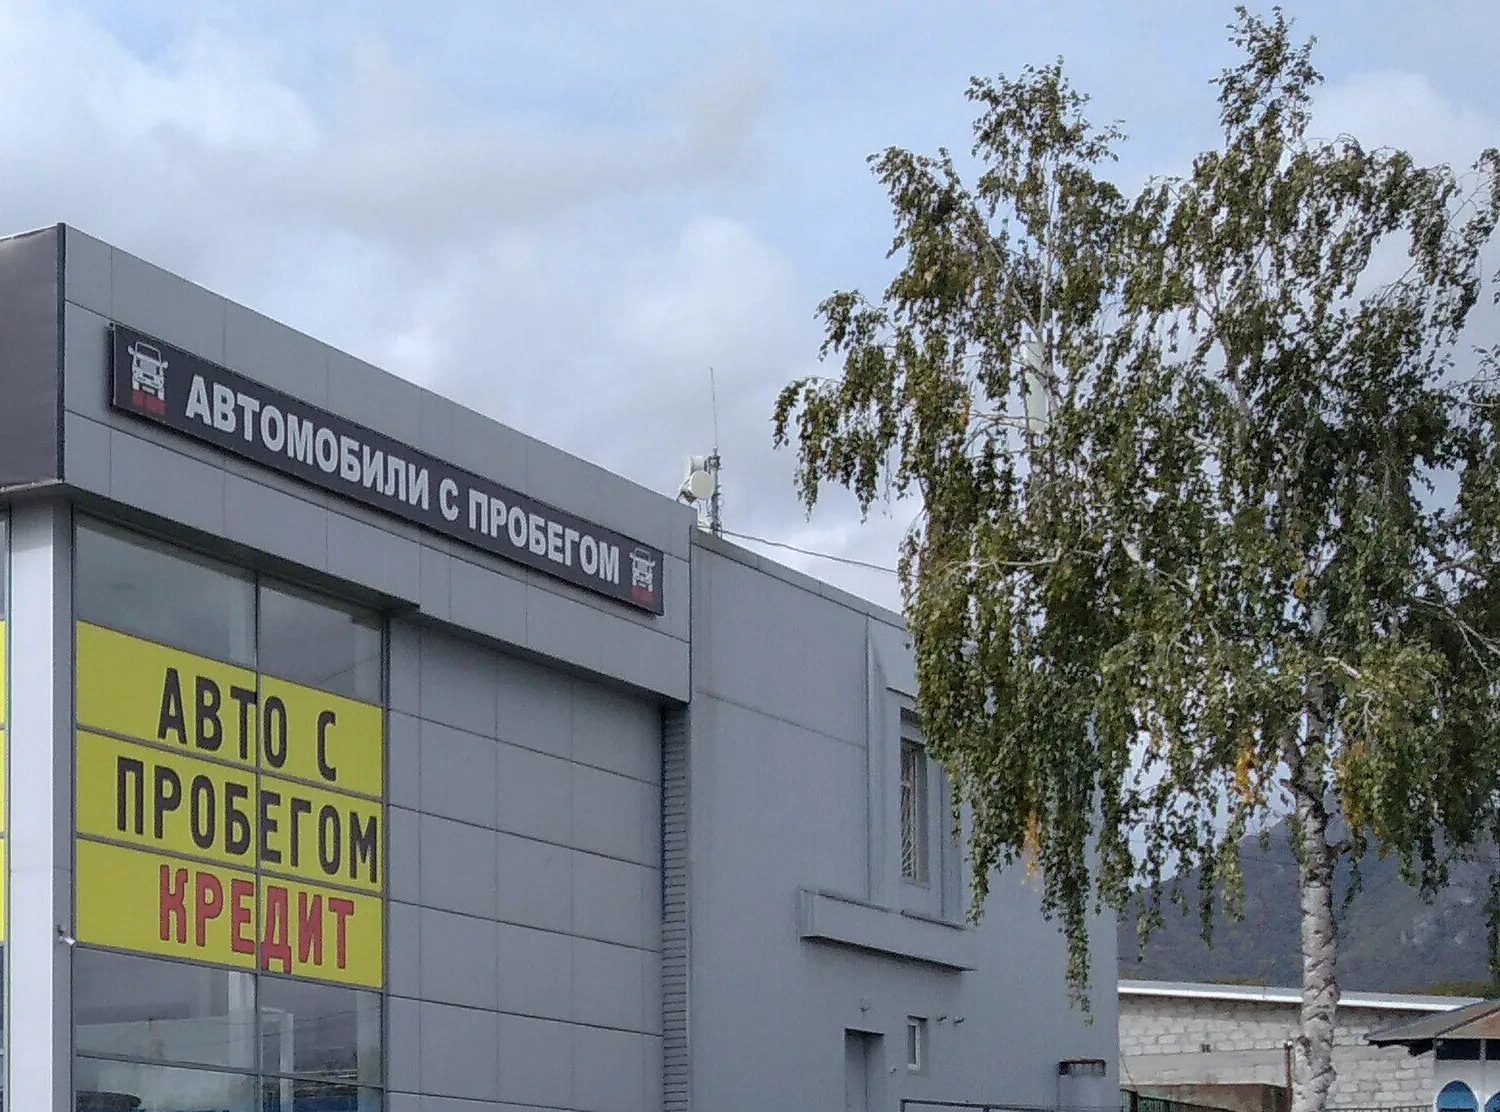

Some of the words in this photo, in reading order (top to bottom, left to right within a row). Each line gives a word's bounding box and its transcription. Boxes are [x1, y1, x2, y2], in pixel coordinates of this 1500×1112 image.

[185, 373, 430, 512] АВТОМОБИЛИ
[438, 479, 460, 522] С
[469, 491, 620, 585] ПРОБЕГОМ
[157, 667, 288, 769] АВТО
[316, 710, 337, 782] С
[116, 755, 378, 884] ПРОБЕГОМ
[160, 864, 355, 974] КРЕДИТ
